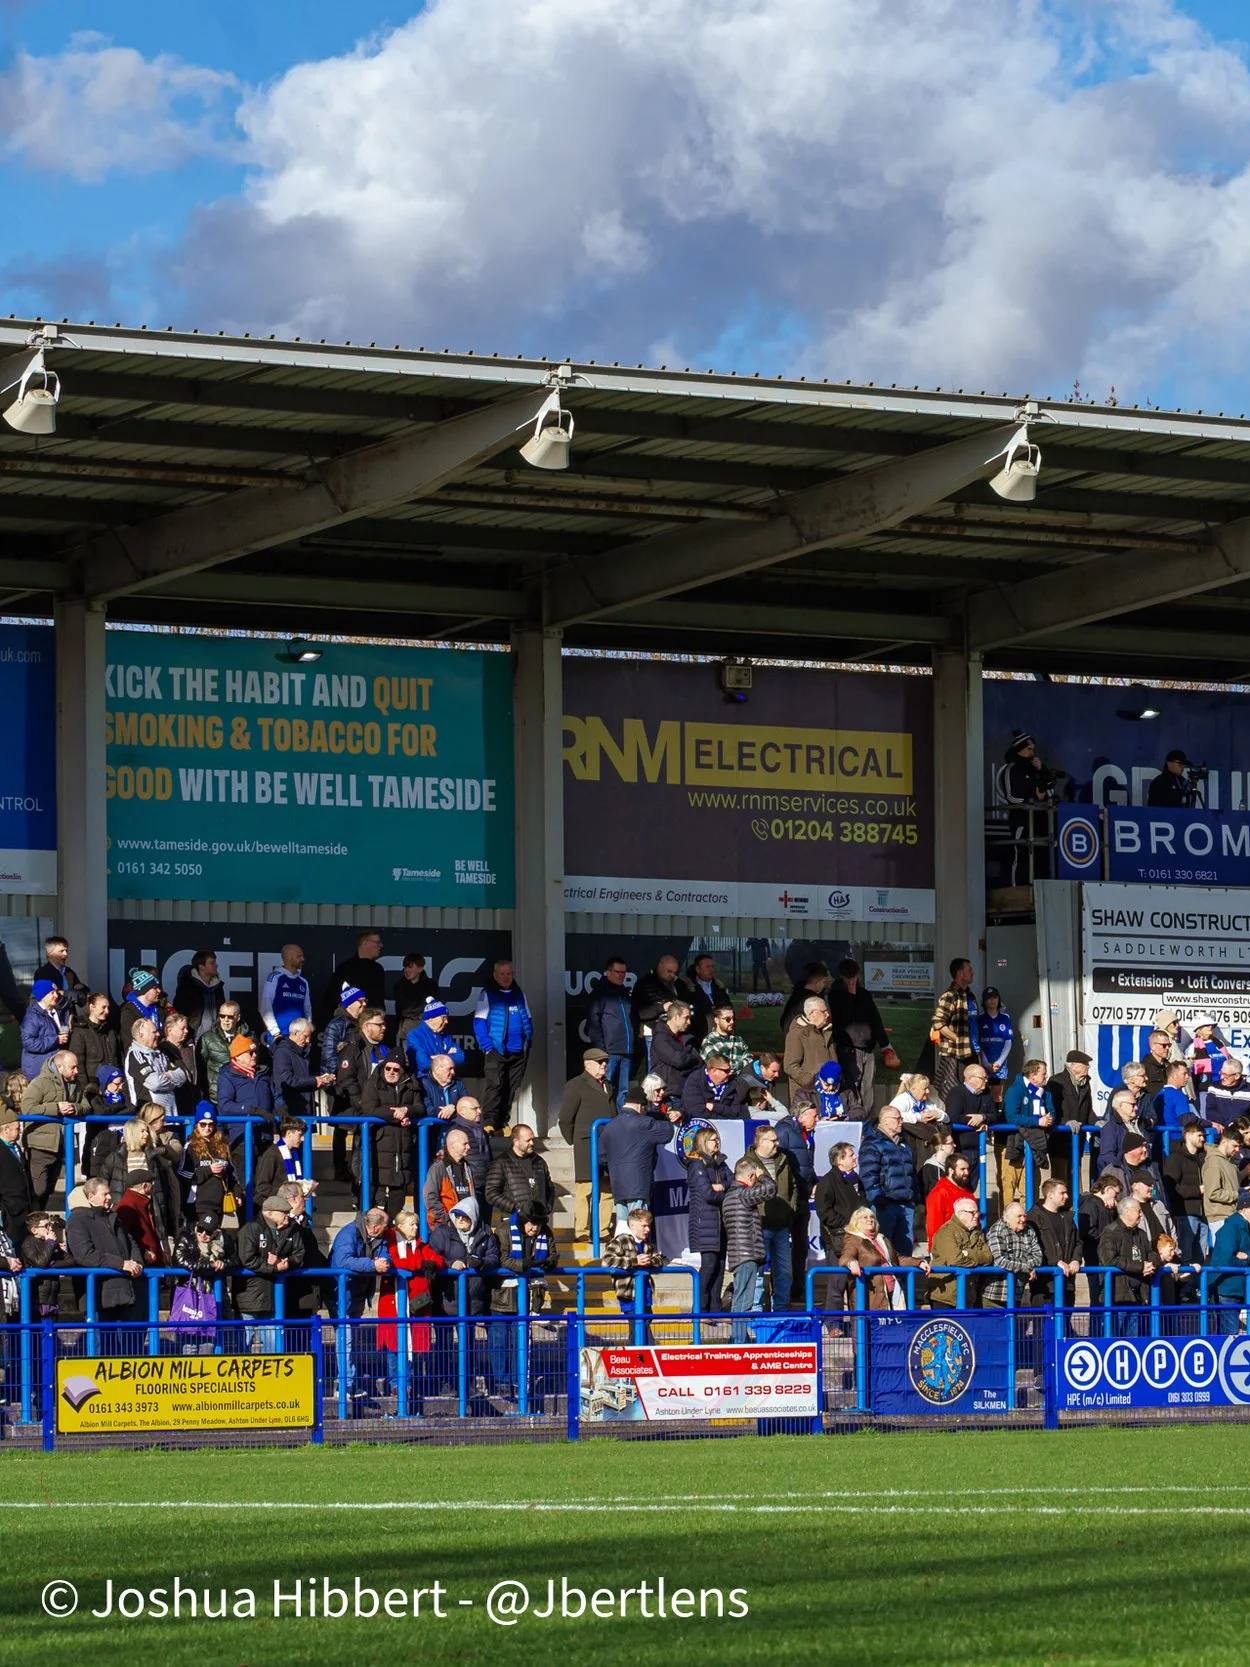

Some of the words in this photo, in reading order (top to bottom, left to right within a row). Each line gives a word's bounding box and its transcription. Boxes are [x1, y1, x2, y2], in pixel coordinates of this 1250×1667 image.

[105, 664, 163, 700] KICK
[169, 668, 219, 702] THE
[226, 670, 305, 706] HABIT
[312, 675, 366, 708] AND
[373, 676, 433, 715] QUIT
[105, 712, 223, 749] SMOKING
[230, 716, 252, 751] &
[257, 717, 381, 755] TOBACCO
[388, 723, 437, 757] FOR
[562, 716, 681, 784] RNM
[695, 740, 903, 779] ELECTRICAL
[105, 765, 172, 800] GOOD
[178, 768, 248, 803] WITH
[255, 770, 288, 805] BE
[293, 772, 362, 807] WELL
[368, 775, 497, 811] TAMESIDE
[687, 791, 917, 817] www.rnmservices.co.uk
[771, 819, 833, 841] 01204
[840, 823, 918, 845] 388745
[117, 837, 348, 856] www.tameside.gov.uk/bewelltameside
[117, 862, 146, 875] 0161
[149, 863, 170, 875] 342
[174, 863, 202, 876] 5050
[402, 866, 441, 878] Tameside
[455, 860, 466, 870] BE
[467, 860, 489, 871] WELL
[455, 872, 496, 884] TAMESIDE
[1149, 869, 1172, 879] 0161
[1174, 870, 1193, 880] 330
[1195, 870, 1218, 881] 6821
[599, 887, 652, 902] Engineers
[655, 890, 663, 901] &
[666, 890, 728, 904] Contractors
[1092, 909, 1143, 927] SHAW
[1104, 942, 1227, 958] SADDLEWORTH
[1118, 973, 1174, 988] Extensions
[1187, 976, 1210, 990] Loft
[1093, 1007, 1123, 1020] 07710
[1127, 1008, 1146, 1020] 577
[913, 1323, 964, 1355] MACCLESFIELD
[961, 1342, 970, 1355] FC
[610, 1354, 631, 1364] Beau
[661, 1352, 702, 1361] Electrical
[704, 1352, 742, 1362] Training,
[743, 1350, 813, 1361] Apprenticeships
[95, 1360, 164, 1381] ALBION
[170, 1359, 212, 1380] MILL
[215, 1358, 294, 1380] CARPETS
[610, 1365, 653, 1375] Associates
[760, 1362, 782, 1370] AM2
[783, 1361, 813, 1370] Centre
[135, 1383, 187, 1395] FLOORING
[190, 1381, 256, 1394] SPECIALISTS
[658, 1387, 695, 1397] CALL
[704, 1386, 740, 1396] 0161
[744, 1385, 772, 1395] 339
[775, 1384, 811, 1395] 8229
[917, 1379, 940, 1401] SINCE
[983, 1389, 997, 1399] The
[89, 1403, 113, 1414] 0161
[115, 1402, 133, 1413] 343
[135, 1402, 159, 1413] 3973
[172, 1398, 300, 1413] www.albionmillcarpets.co.uk
[973, 1400, 1007, 1411] SILKMEN
[1067, 1393, 1081, 1406] HPE
[1082, 1392, 1104, 1407] (m/c)
[1105, 1392, 1131, 1405] Limited
[655, 1407, 680, 1415] Ashton
[705, 1406, 721, 1416] Lyne
[112, 1420, 137, 1428] Carpets,
[151, 1419, 171, 1427] Albion,
[182, 1419, 199, 1427] Penny
[229, 1417, 249, 1425] Ashton
